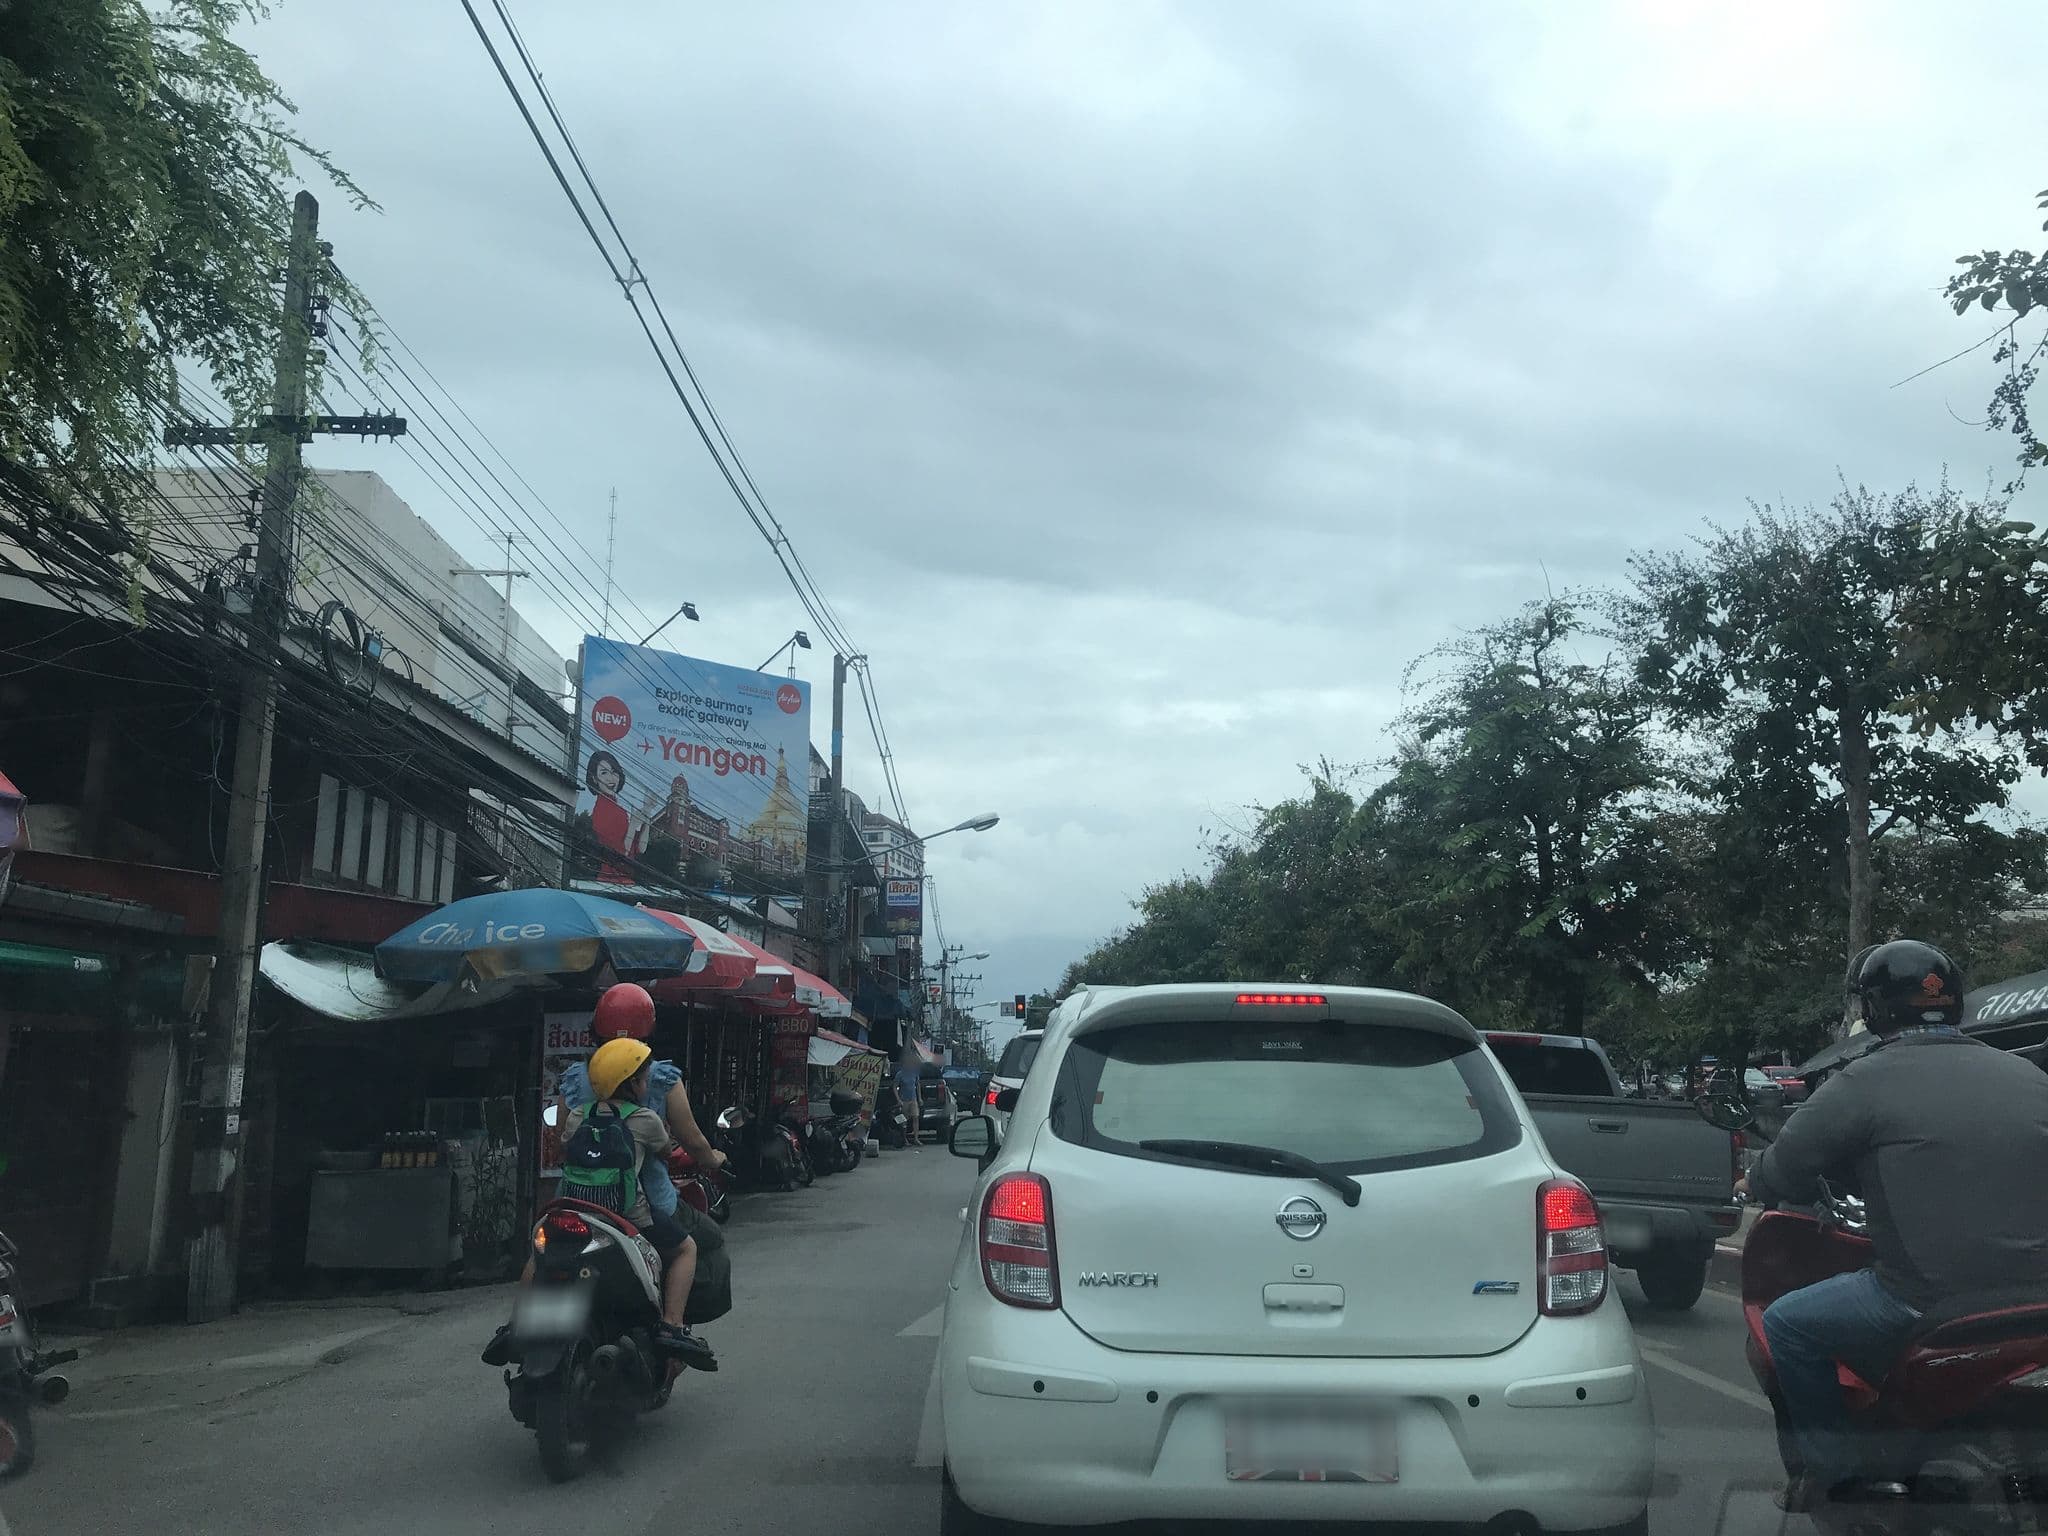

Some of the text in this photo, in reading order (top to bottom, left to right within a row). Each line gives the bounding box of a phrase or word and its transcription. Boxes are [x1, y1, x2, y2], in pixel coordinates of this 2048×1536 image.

[655, 687, 753, 716] Explore Burma's
[595, 711, 627, 727] NEW!
[658, 702, 750, 732] exotic gateway
[725, 736, 753, 750] Chiang
[753, 741, 767, 751] Mai
[658, 735, 767, 776] Yangon
[1280, 1213, 1321, 1222] NISSAN
[1079, 1271, 1159, 1288] MARCH
